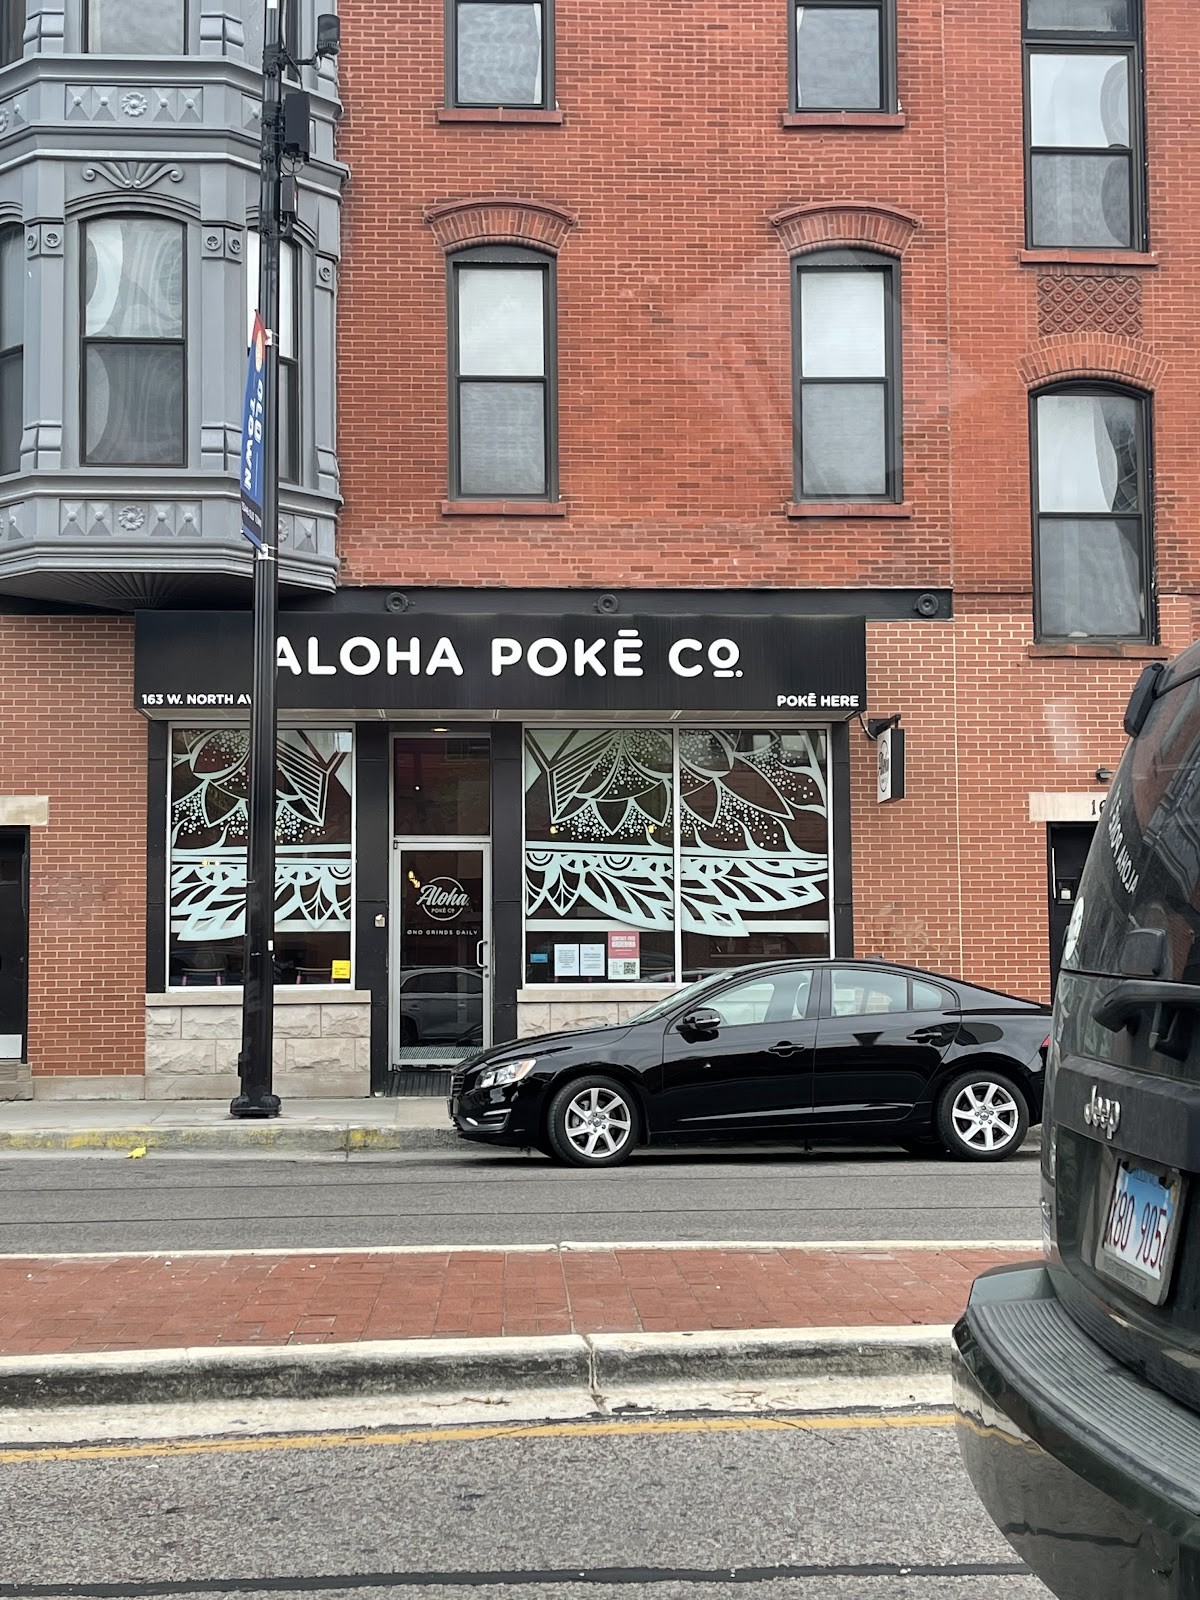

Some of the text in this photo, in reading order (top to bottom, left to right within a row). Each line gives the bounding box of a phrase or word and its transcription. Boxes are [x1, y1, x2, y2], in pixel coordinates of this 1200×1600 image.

[254, 379, 264, 443] OLD
[244, 398, 256, 491] TOWN
[276, 635, 464, 676] ALOHA
[141, 693, 164, 705] 163
[166, 693, 184, 705] W.
[186, 693, 234, 705] NORTH
[820, 695, 860, 707] HERE
[416, 884, 470, 906] Aloha
[1084, 1085, 1121, 1140] Jeep
[1135, 1202, 1170, 1272] 905
